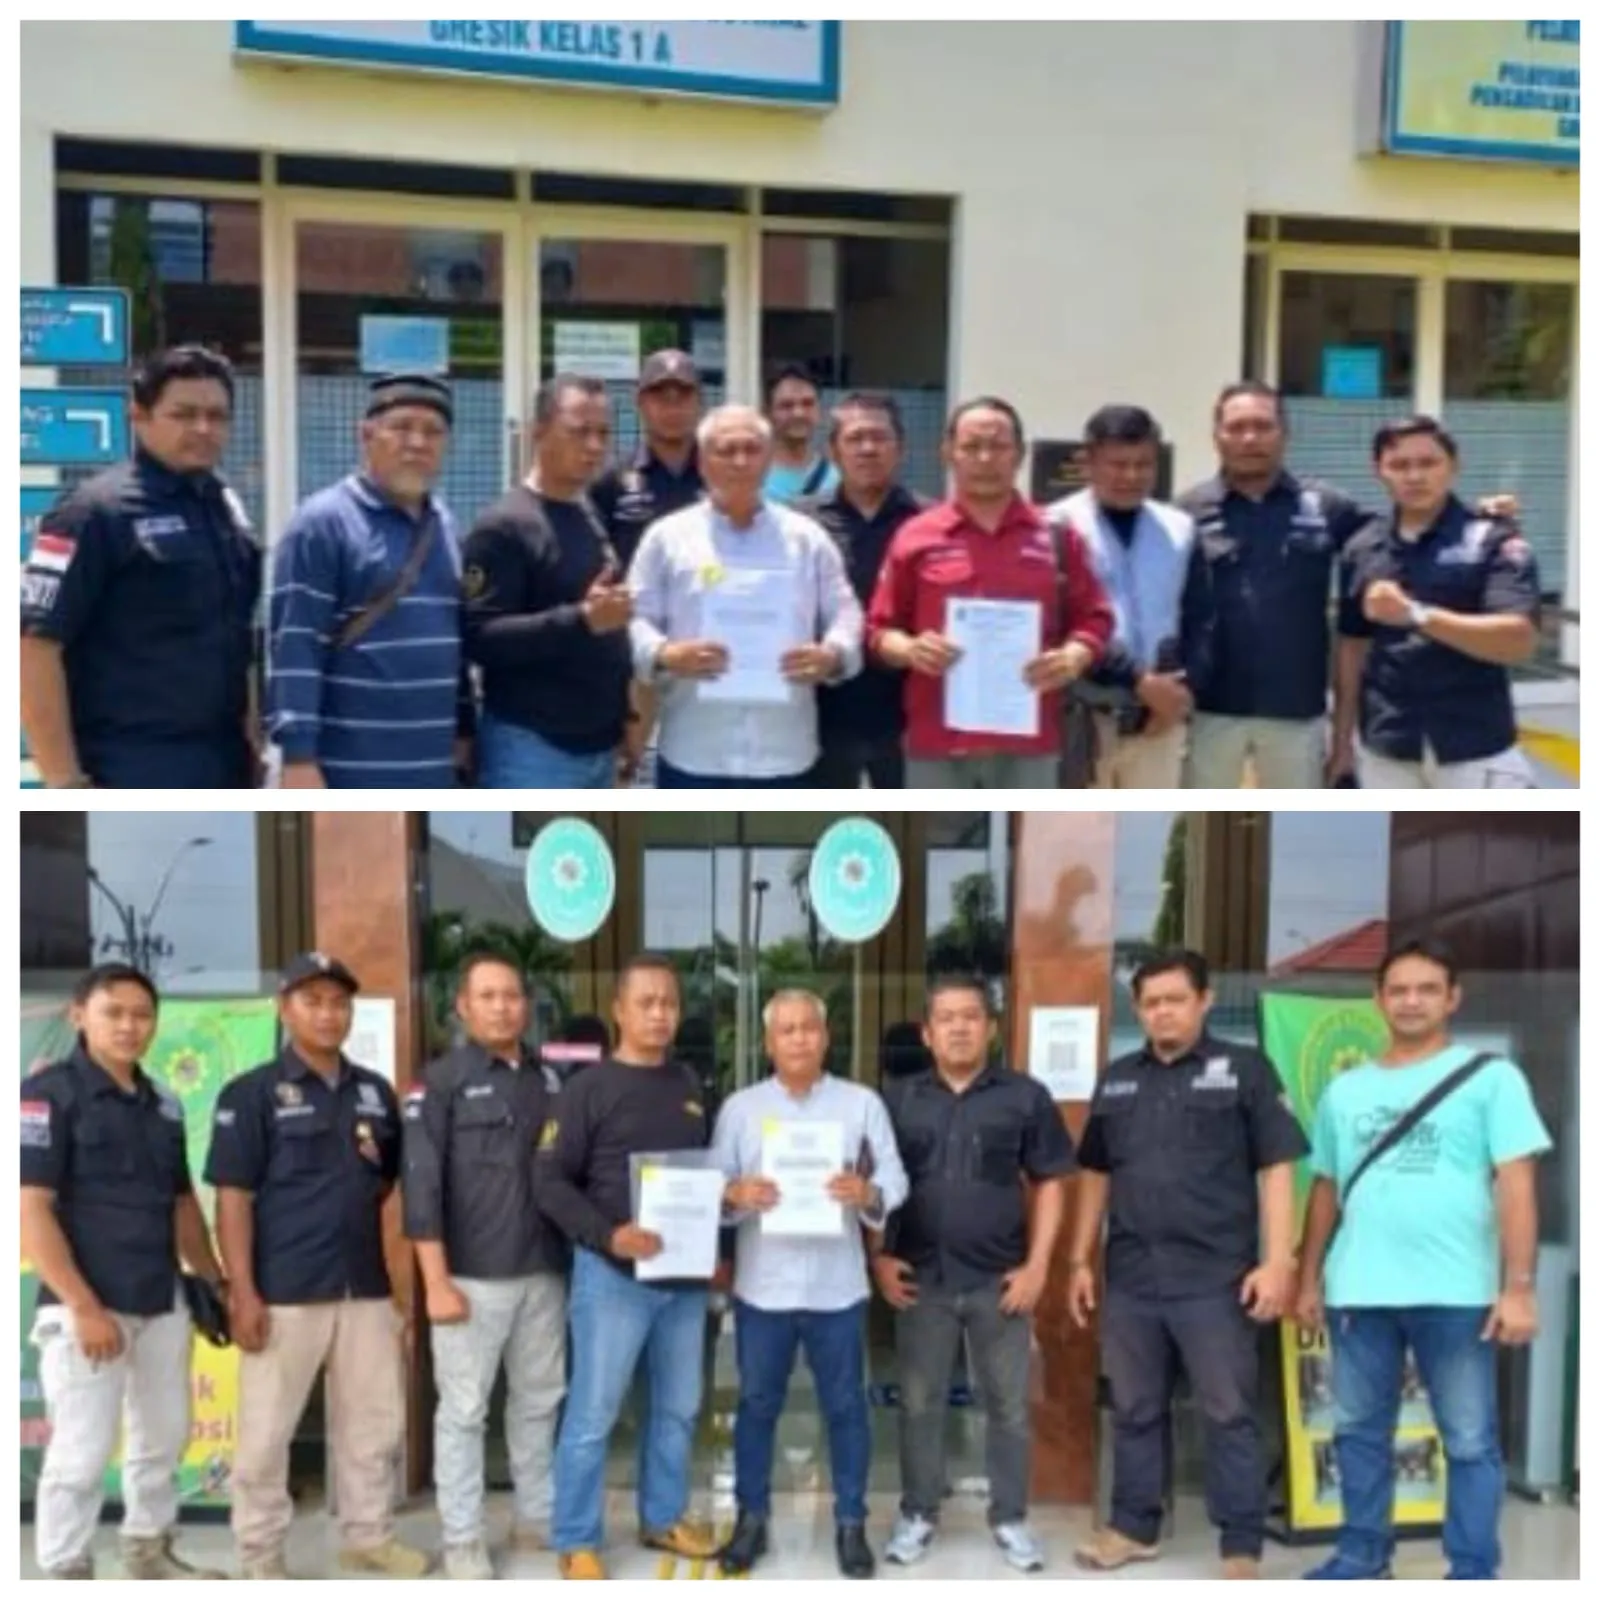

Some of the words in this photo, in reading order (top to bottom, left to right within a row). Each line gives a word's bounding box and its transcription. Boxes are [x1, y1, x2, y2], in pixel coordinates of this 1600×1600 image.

[540, 21, 622, 60] KELAS
[630, 30, 644, 62] 1
[653, 31, 672, 65] A
